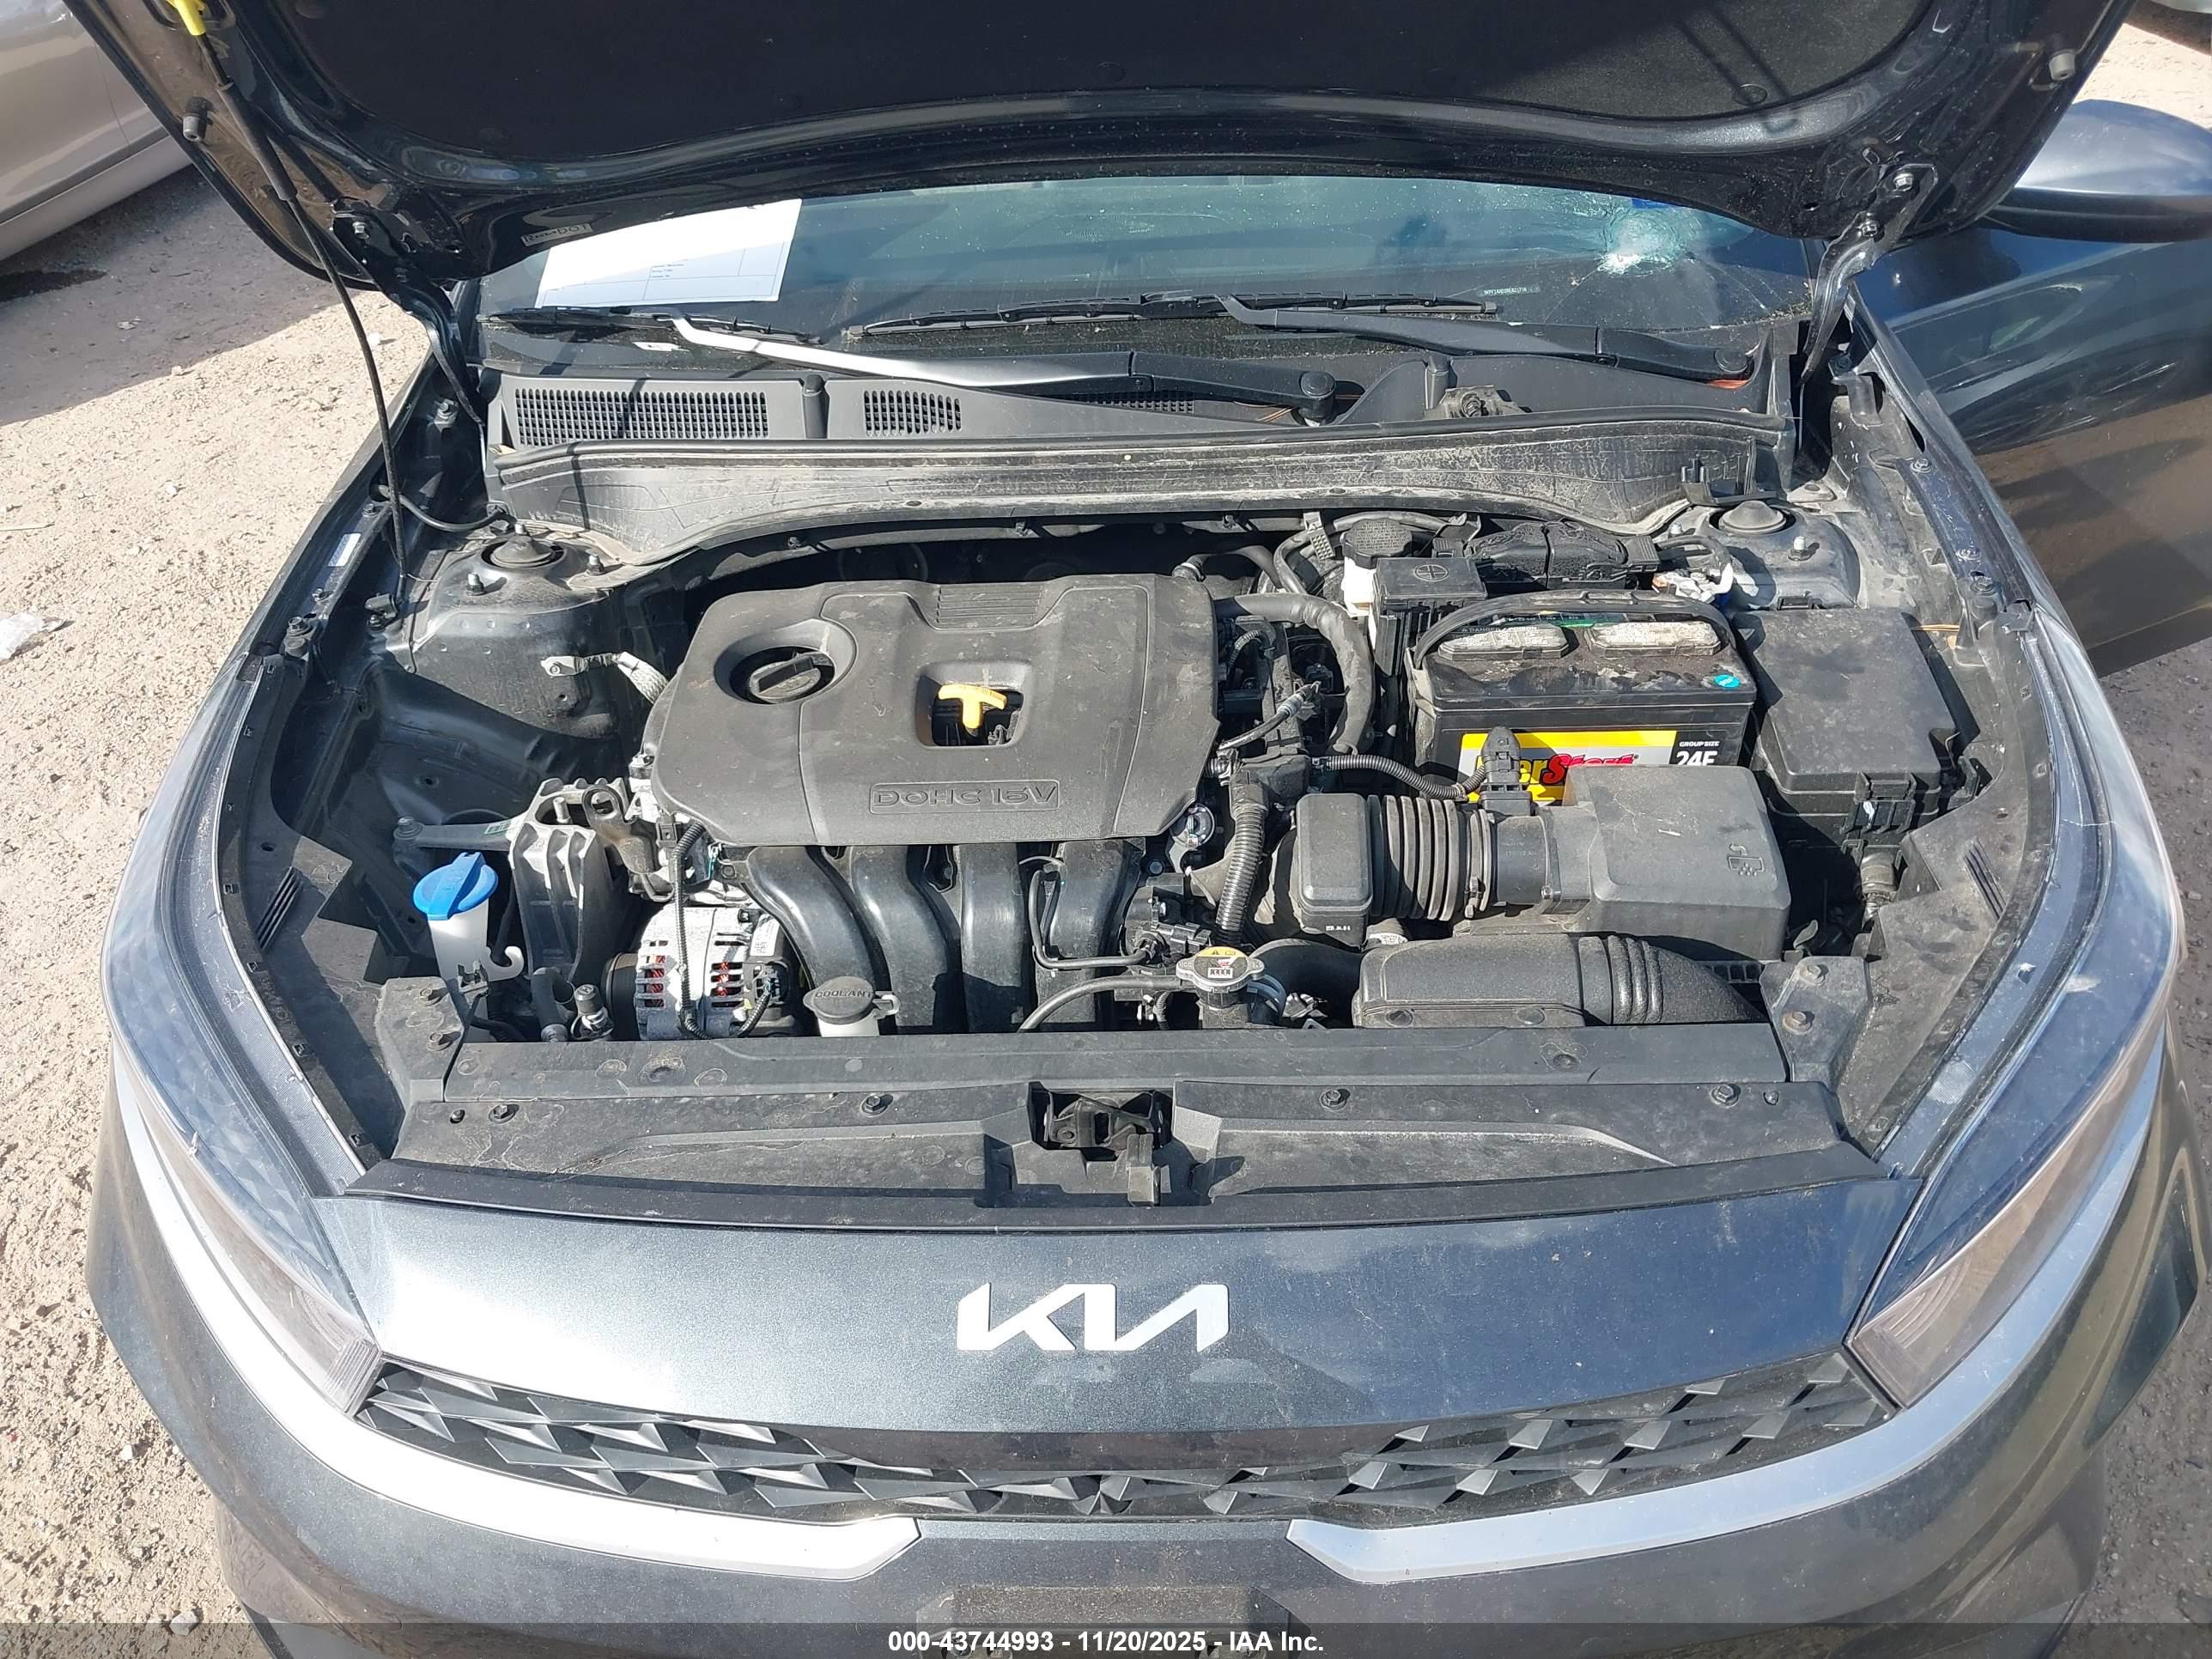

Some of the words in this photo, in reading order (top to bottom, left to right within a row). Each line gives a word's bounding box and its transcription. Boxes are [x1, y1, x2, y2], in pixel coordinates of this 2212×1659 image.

[872, 789, 981, 806] DOHC
[990, 786, 1056, 805] 16V
[815, 990, 872, 999] COOLANT
[957, 1282, 1230, 1352] KIA
